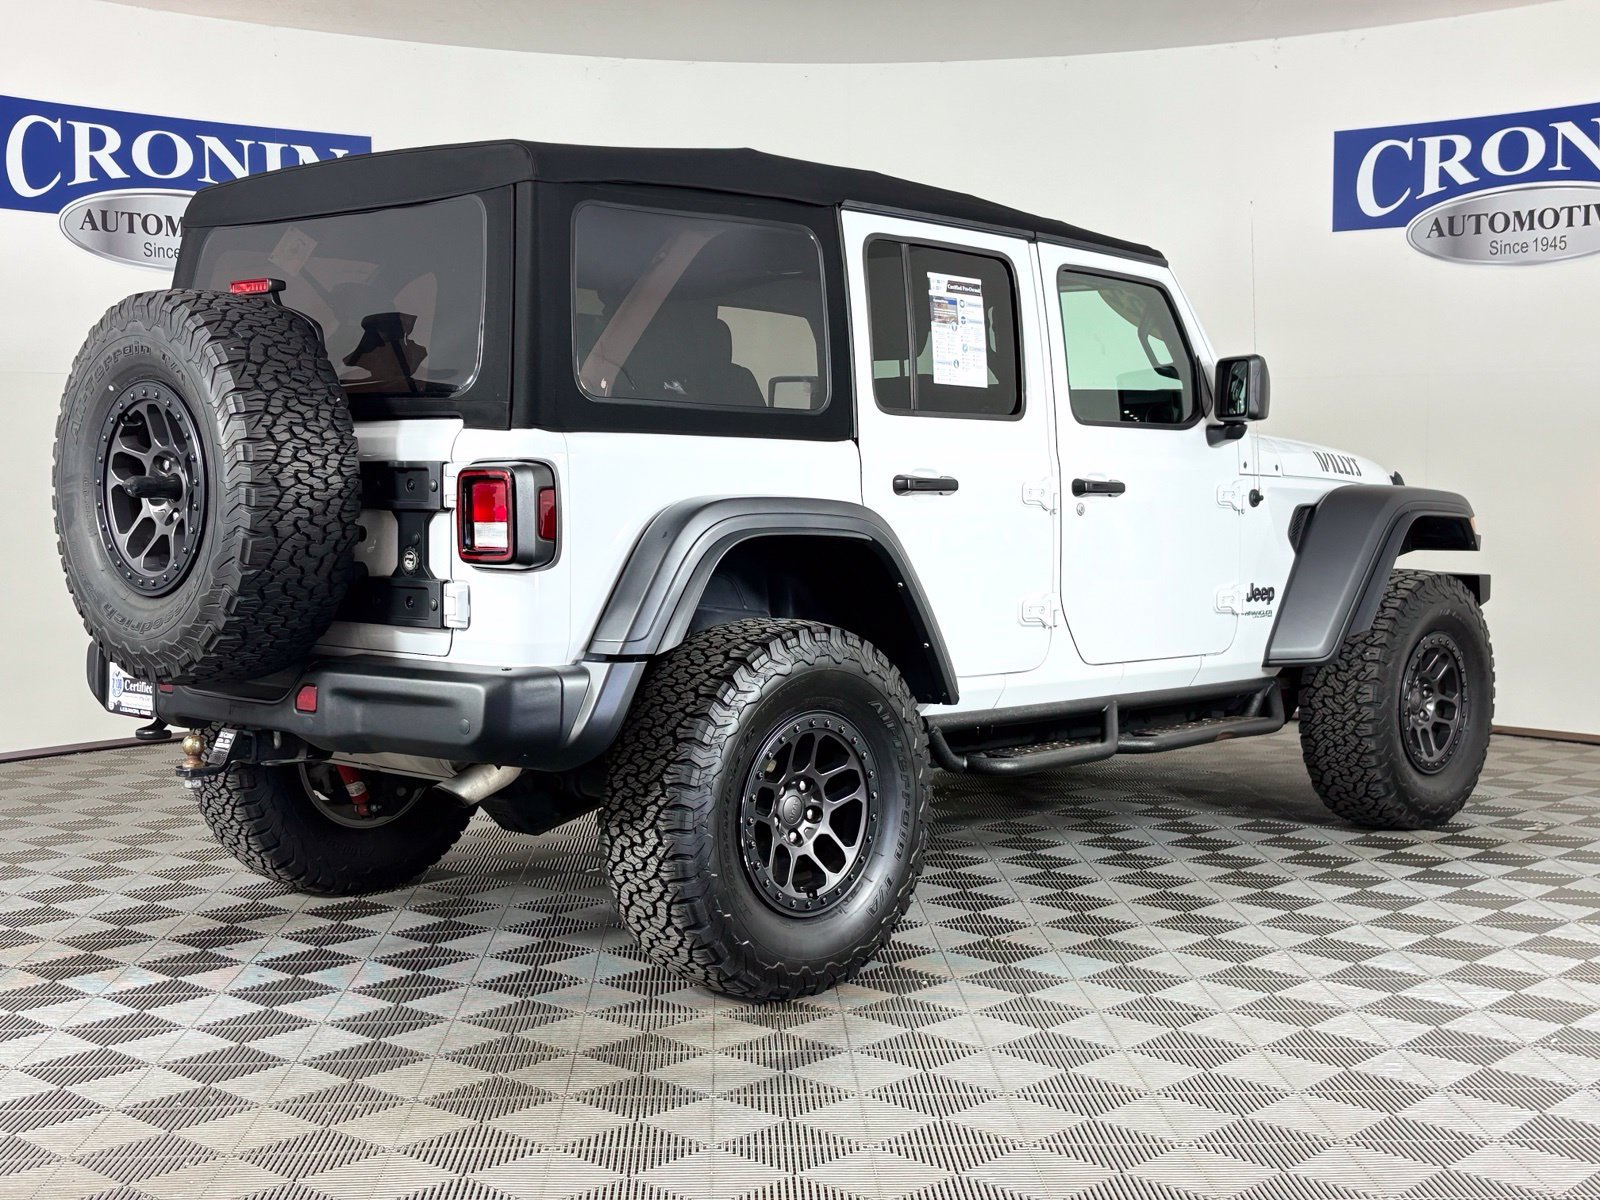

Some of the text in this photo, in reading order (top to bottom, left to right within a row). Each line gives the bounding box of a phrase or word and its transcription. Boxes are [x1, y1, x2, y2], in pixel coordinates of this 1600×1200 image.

[1489, 235, 1568, 256] Since 1945
[1246, 582, 1275, 605] Jeep
